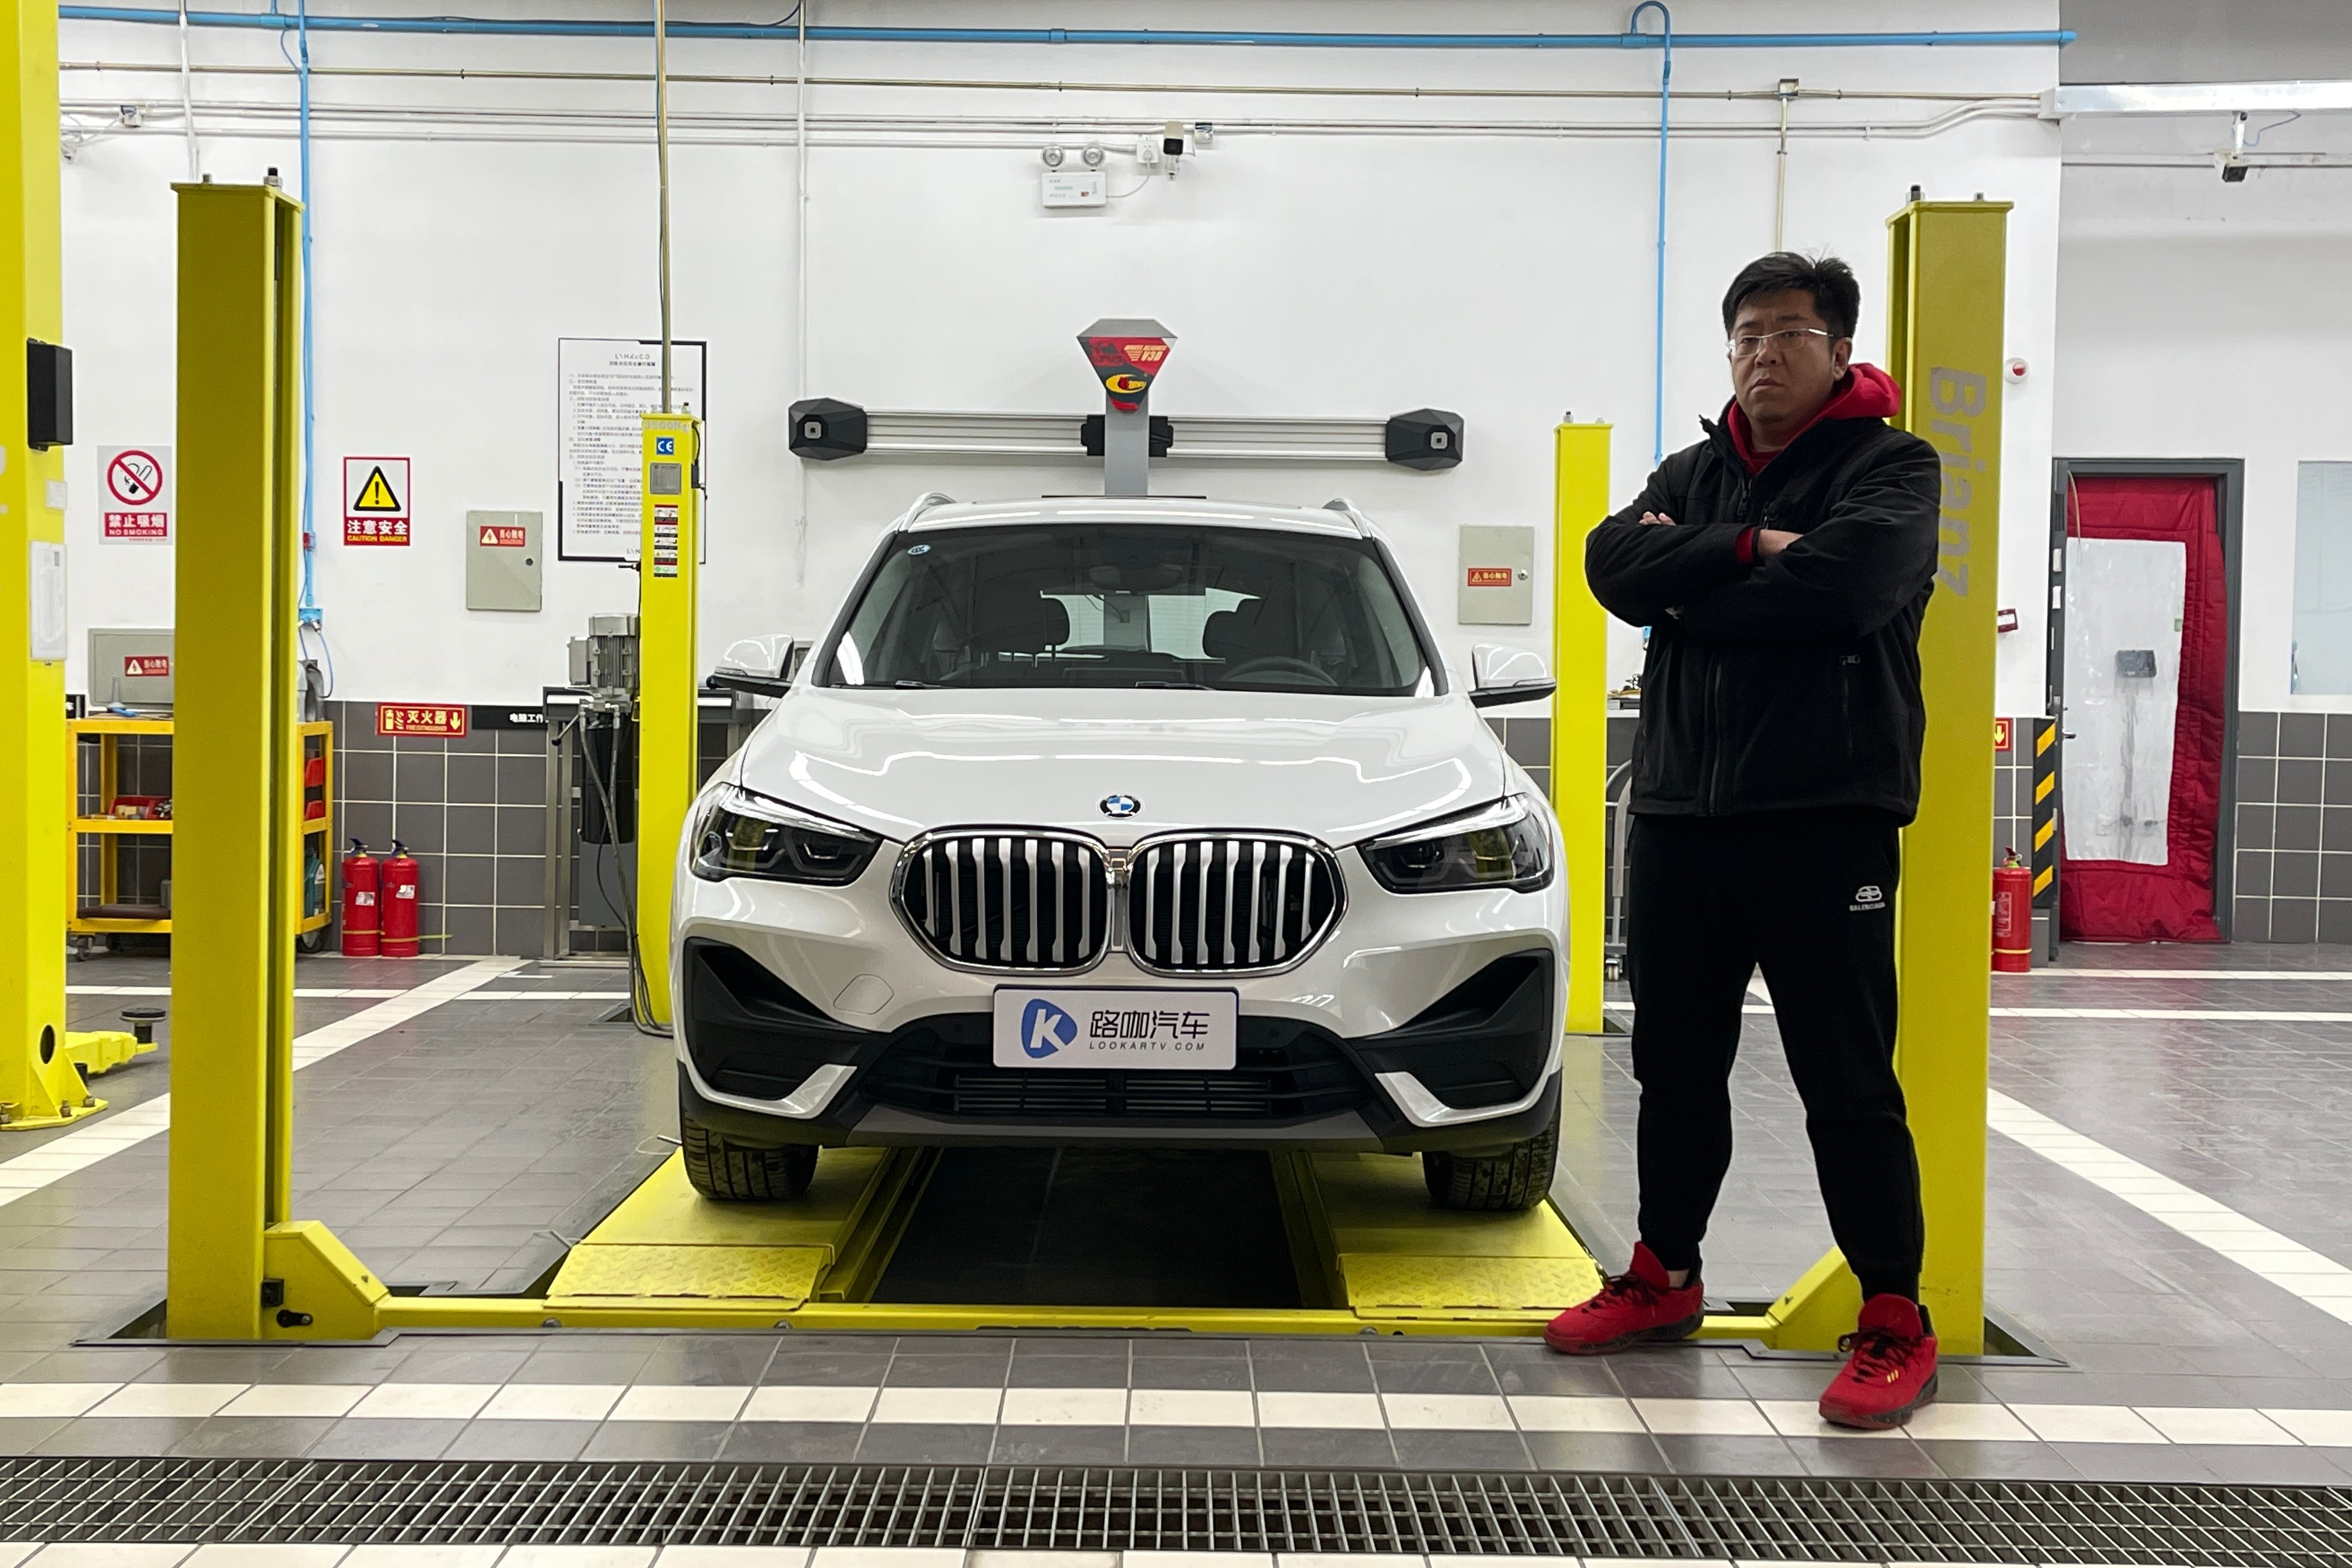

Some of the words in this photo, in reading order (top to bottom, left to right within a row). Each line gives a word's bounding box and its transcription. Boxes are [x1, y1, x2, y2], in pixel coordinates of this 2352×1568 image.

[658, 441, 673, 452] CE
[108, 514, 164, 527] 禁止吸烟
[348, 520, 408, 535] 注意安全
[407, 710, 447, 724] 灭火器
[1090, 1010, 1210, 1039] 路咖汽车
